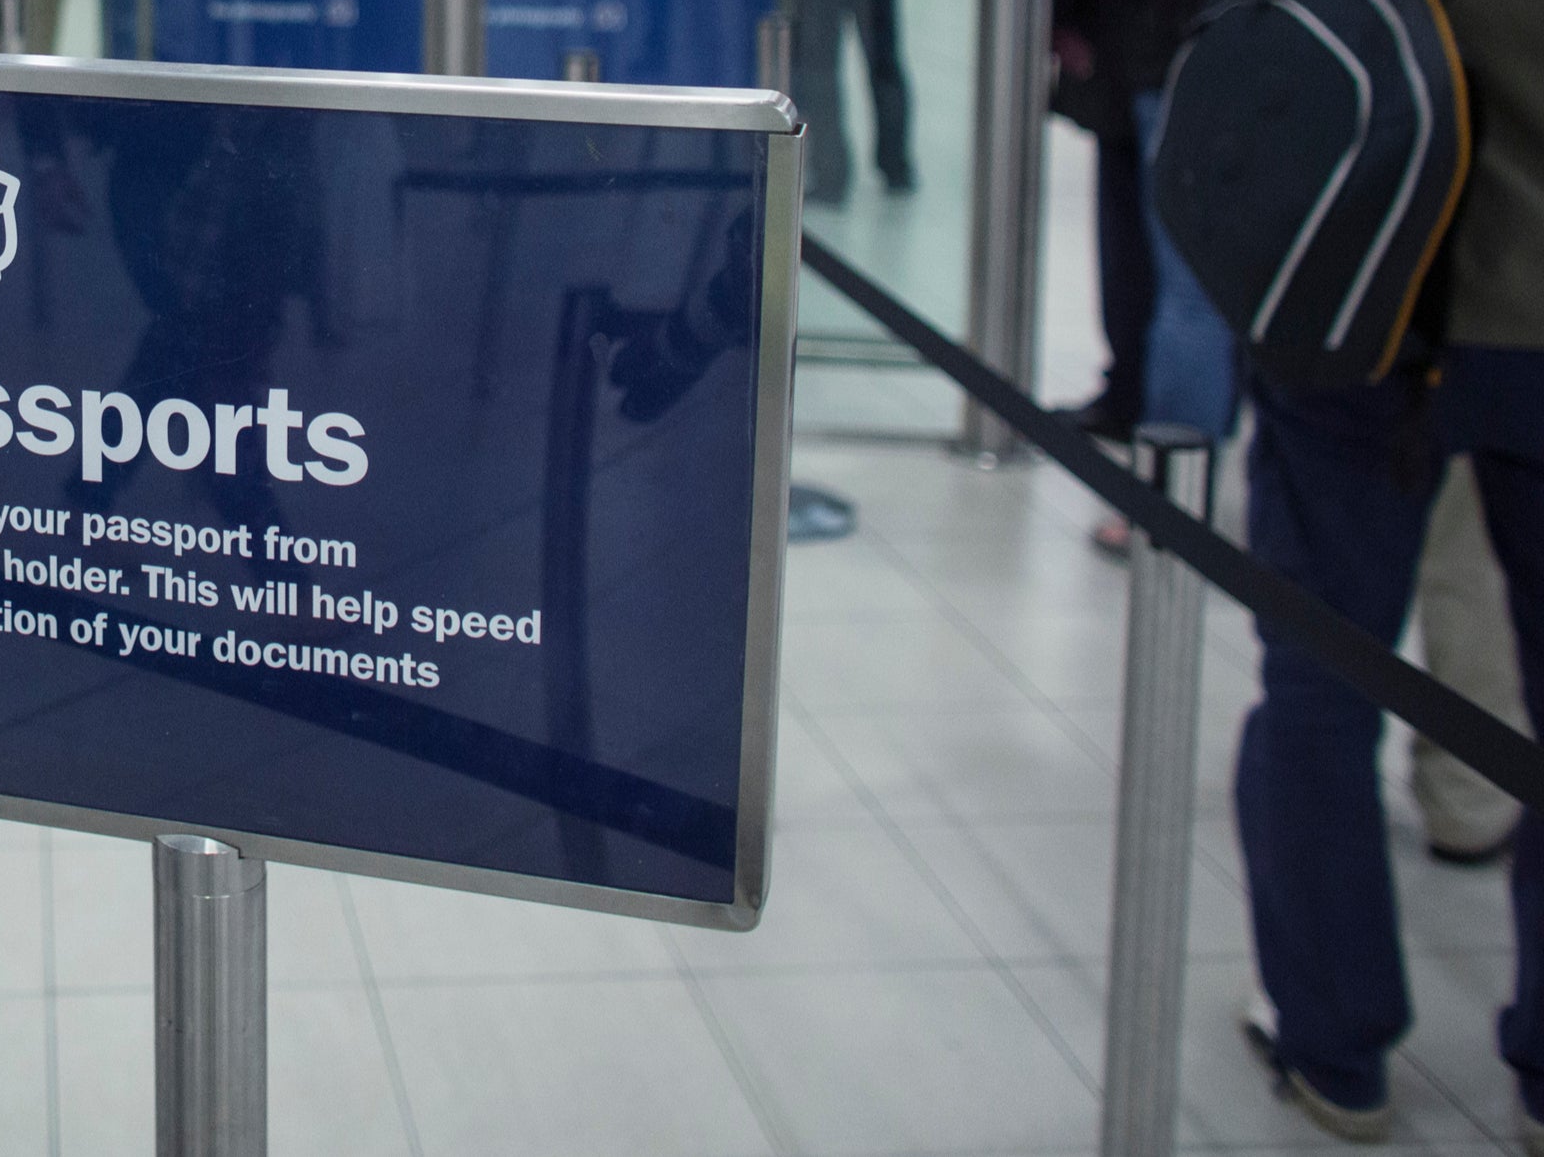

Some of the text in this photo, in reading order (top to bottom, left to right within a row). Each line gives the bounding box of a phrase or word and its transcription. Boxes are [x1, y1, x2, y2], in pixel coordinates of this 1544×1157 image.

[82, 513, 253, 558] passport
[263, 526, 357, 569] from
[3, 549, 130, 597] holder.
[141, 564, 219, 608] This
[230, 582, 298, 617] will
[312, 585, 399, 635] help
[411, 606, 542, 645] speed
[70, 613, 108, 646] of
[118, 623, 201, 657] your
[213, 630, 441, 689] documents
